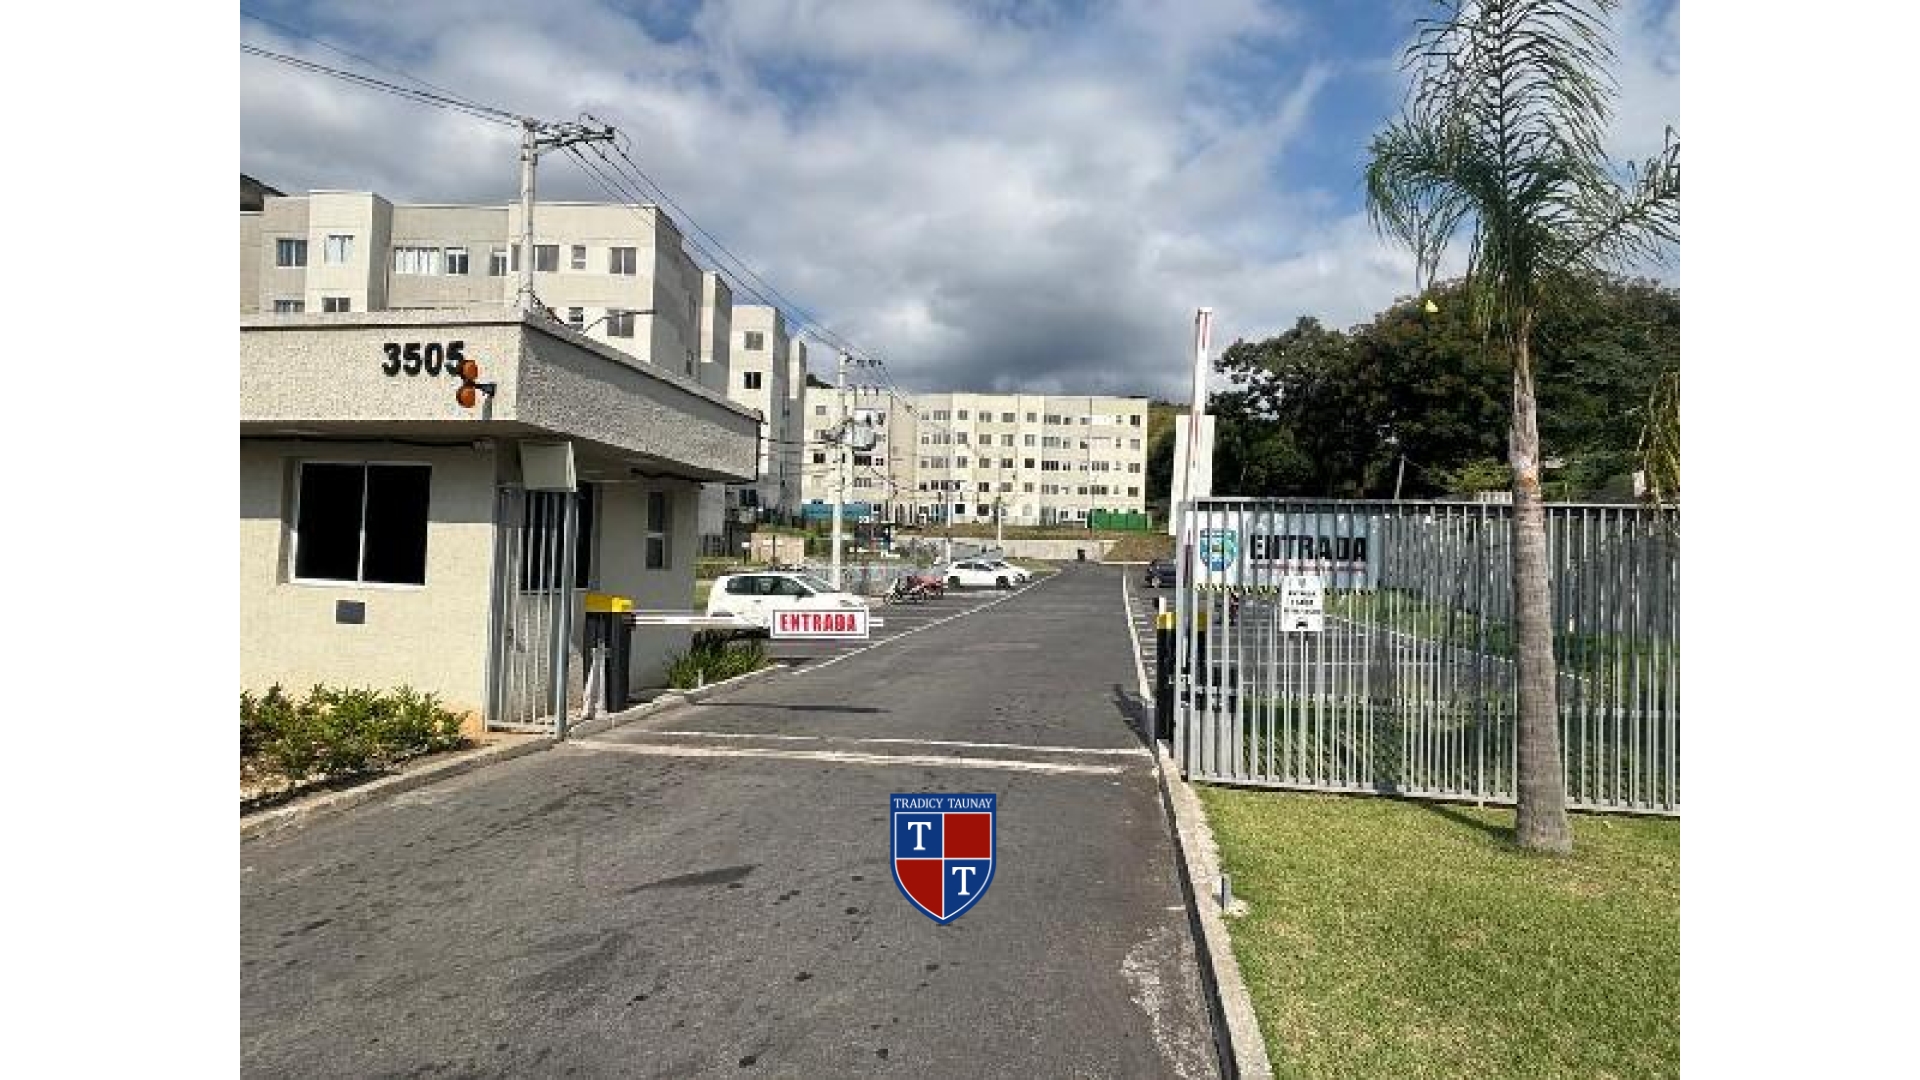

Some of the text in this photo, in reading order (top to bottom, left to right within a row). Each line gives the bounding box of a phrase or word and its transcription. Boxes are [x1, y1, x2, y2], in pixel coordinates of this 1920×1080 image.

[382, 341, 465, 377] 3505
[1250, 534, 1367, 562] ENTRADA
[780, 613, 857, 632] ENTRADA
